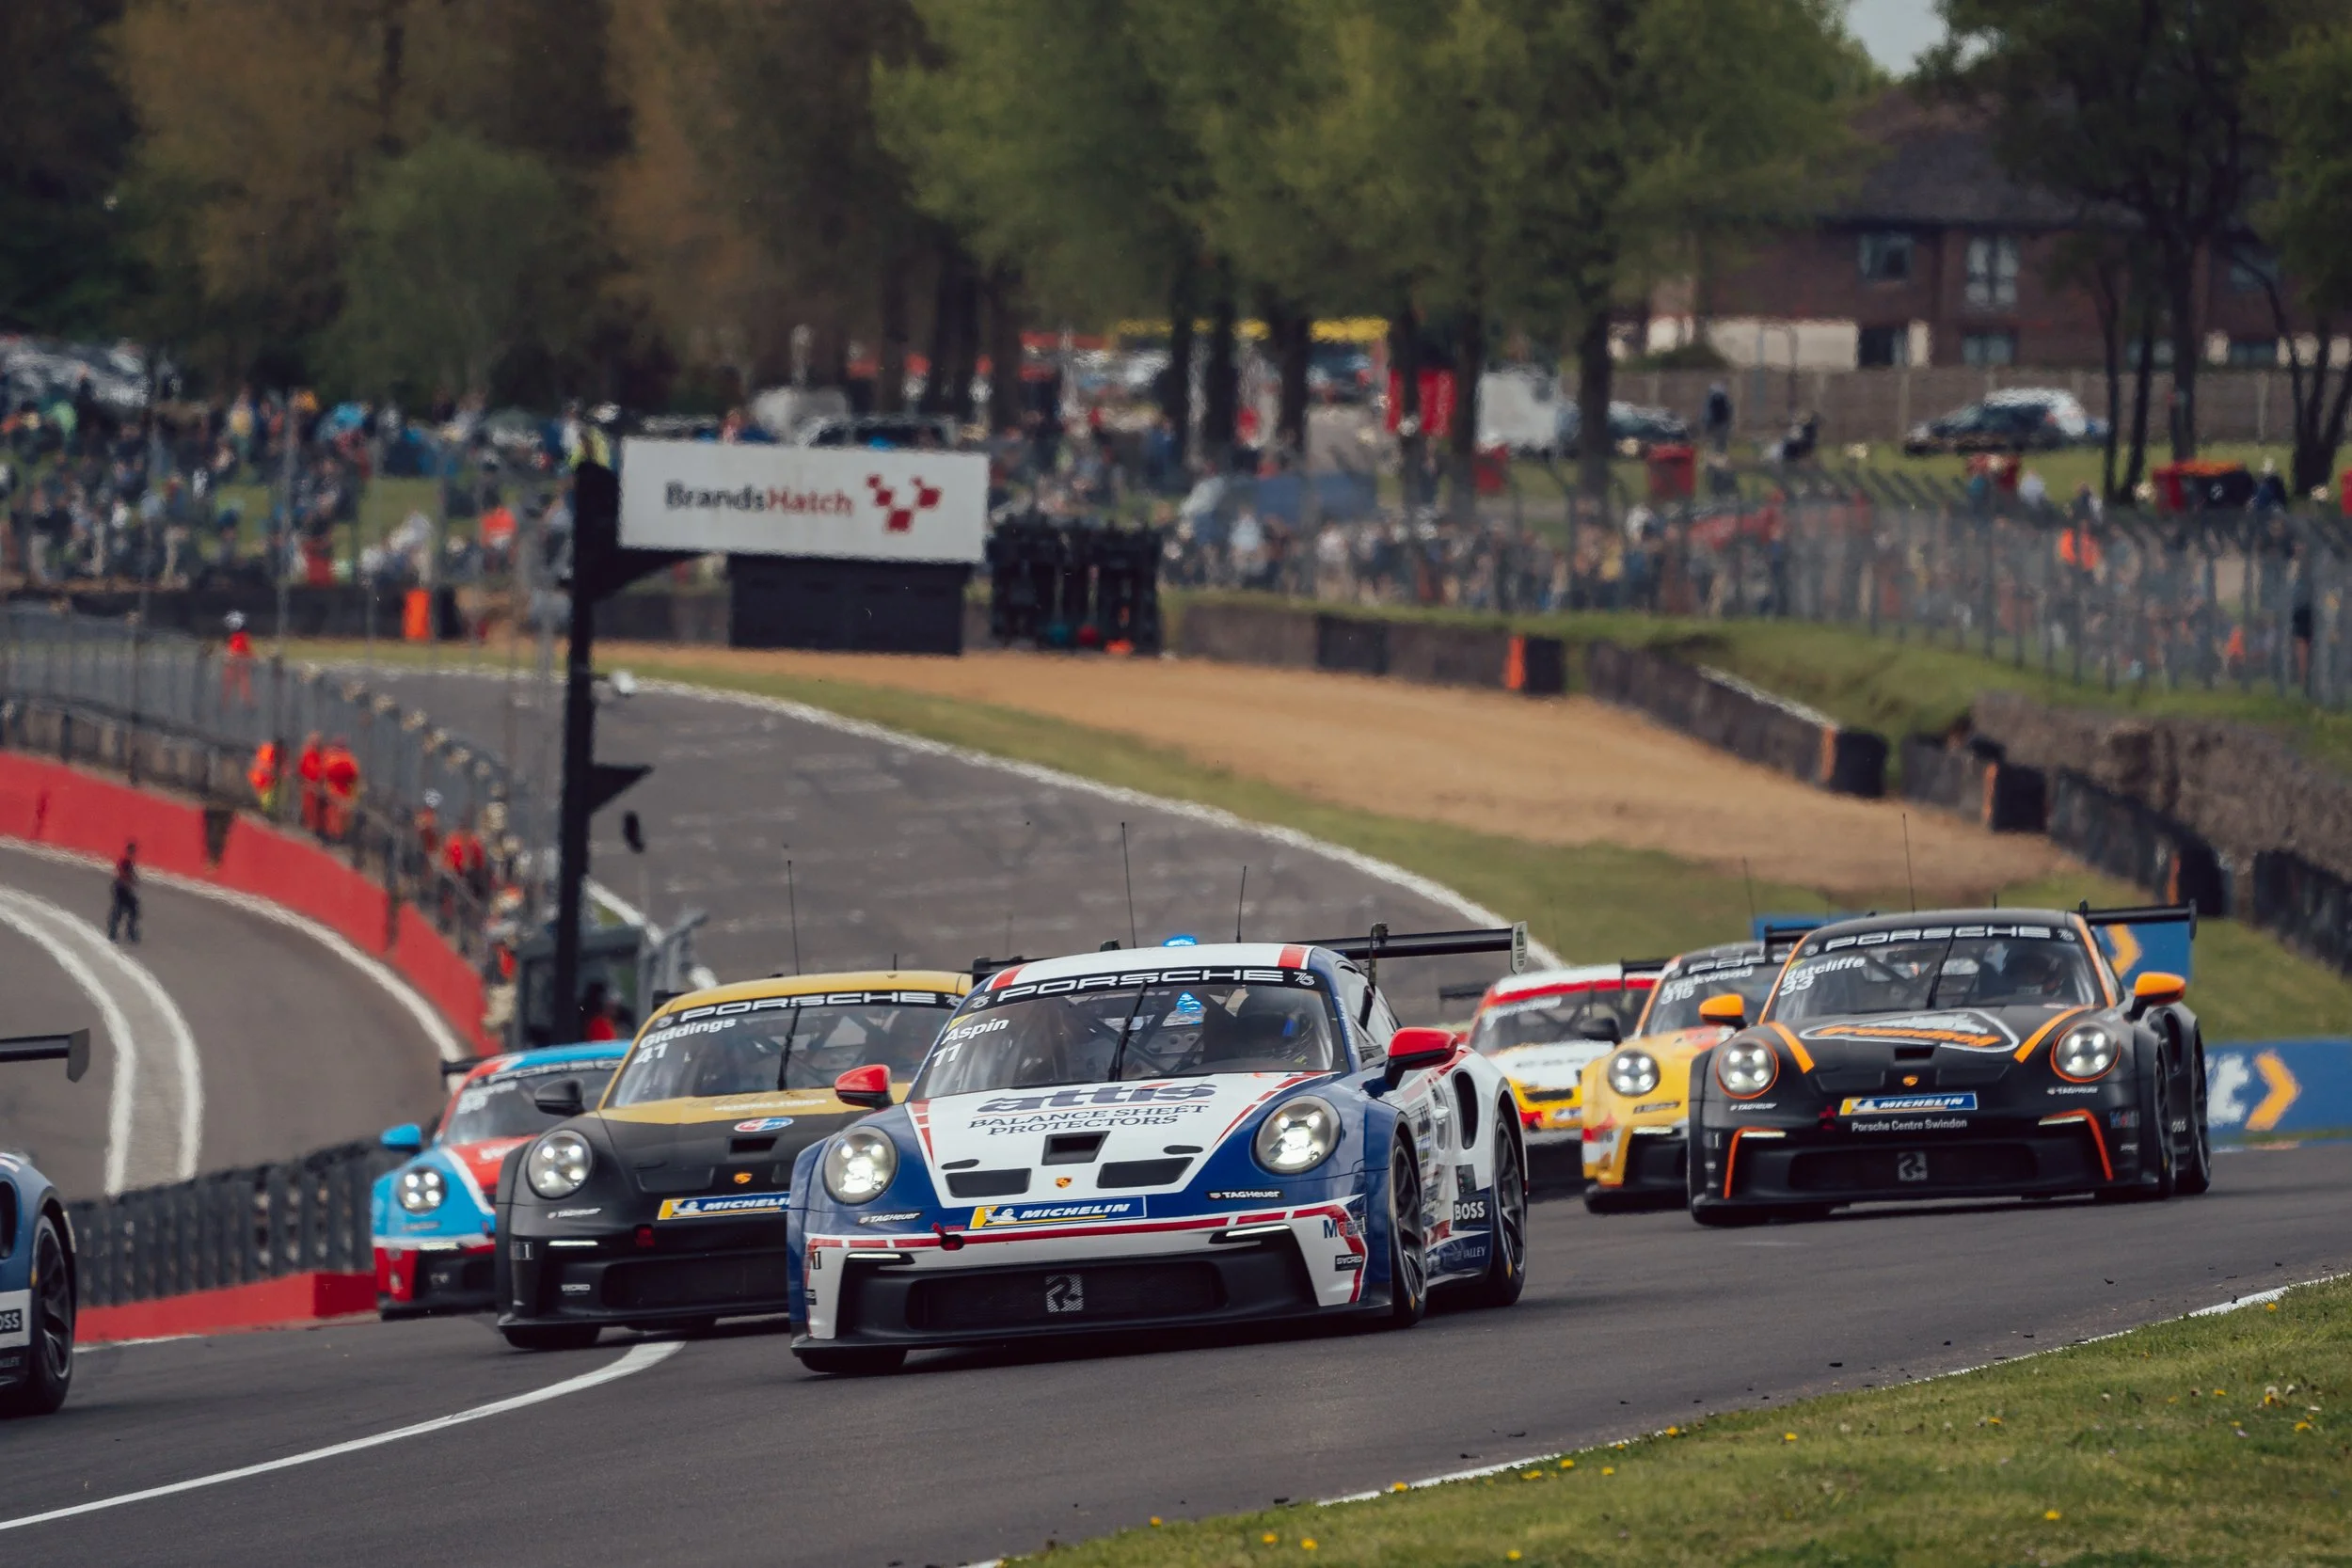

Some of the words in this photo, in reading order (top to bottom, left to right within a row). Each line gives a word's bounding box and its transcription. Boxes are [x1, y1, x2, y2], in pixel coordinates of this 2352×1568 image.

[1825, 926, 2051, 952] PORSCHE
[996, 969, 1284, 1003] PORSCHE
[680, 992, 937, 1022] PORSCHE
[639, 1018, 737, 1049] Giddings
[941, 1018, 1009, 1045] Aspin
[632, 1042, 669, 1065] 41
[932, 1043, 963, 1068] 11
[977, 1083, 1217, 1113] attis
[1879, 1097, 1964, 1110] MICHELIN
[968, 1110, 1108, 1129] BALANCE
[1113, 1104, 1209, 1117] SHEET
[987, 1116, 1179, 1136] PROTECTORS
[1851, 1120, 1890, 1132] Porsche
[1891, 1119, 1923, 1131] Centre
[1925, 1117, 1967, 1130] Swindon
[704, 1197, 790, 1211] MICHELI
[1020, 1203, 1131, 1219] MICHELIN
[1454, 1201, 1486, 1220] BOSS
